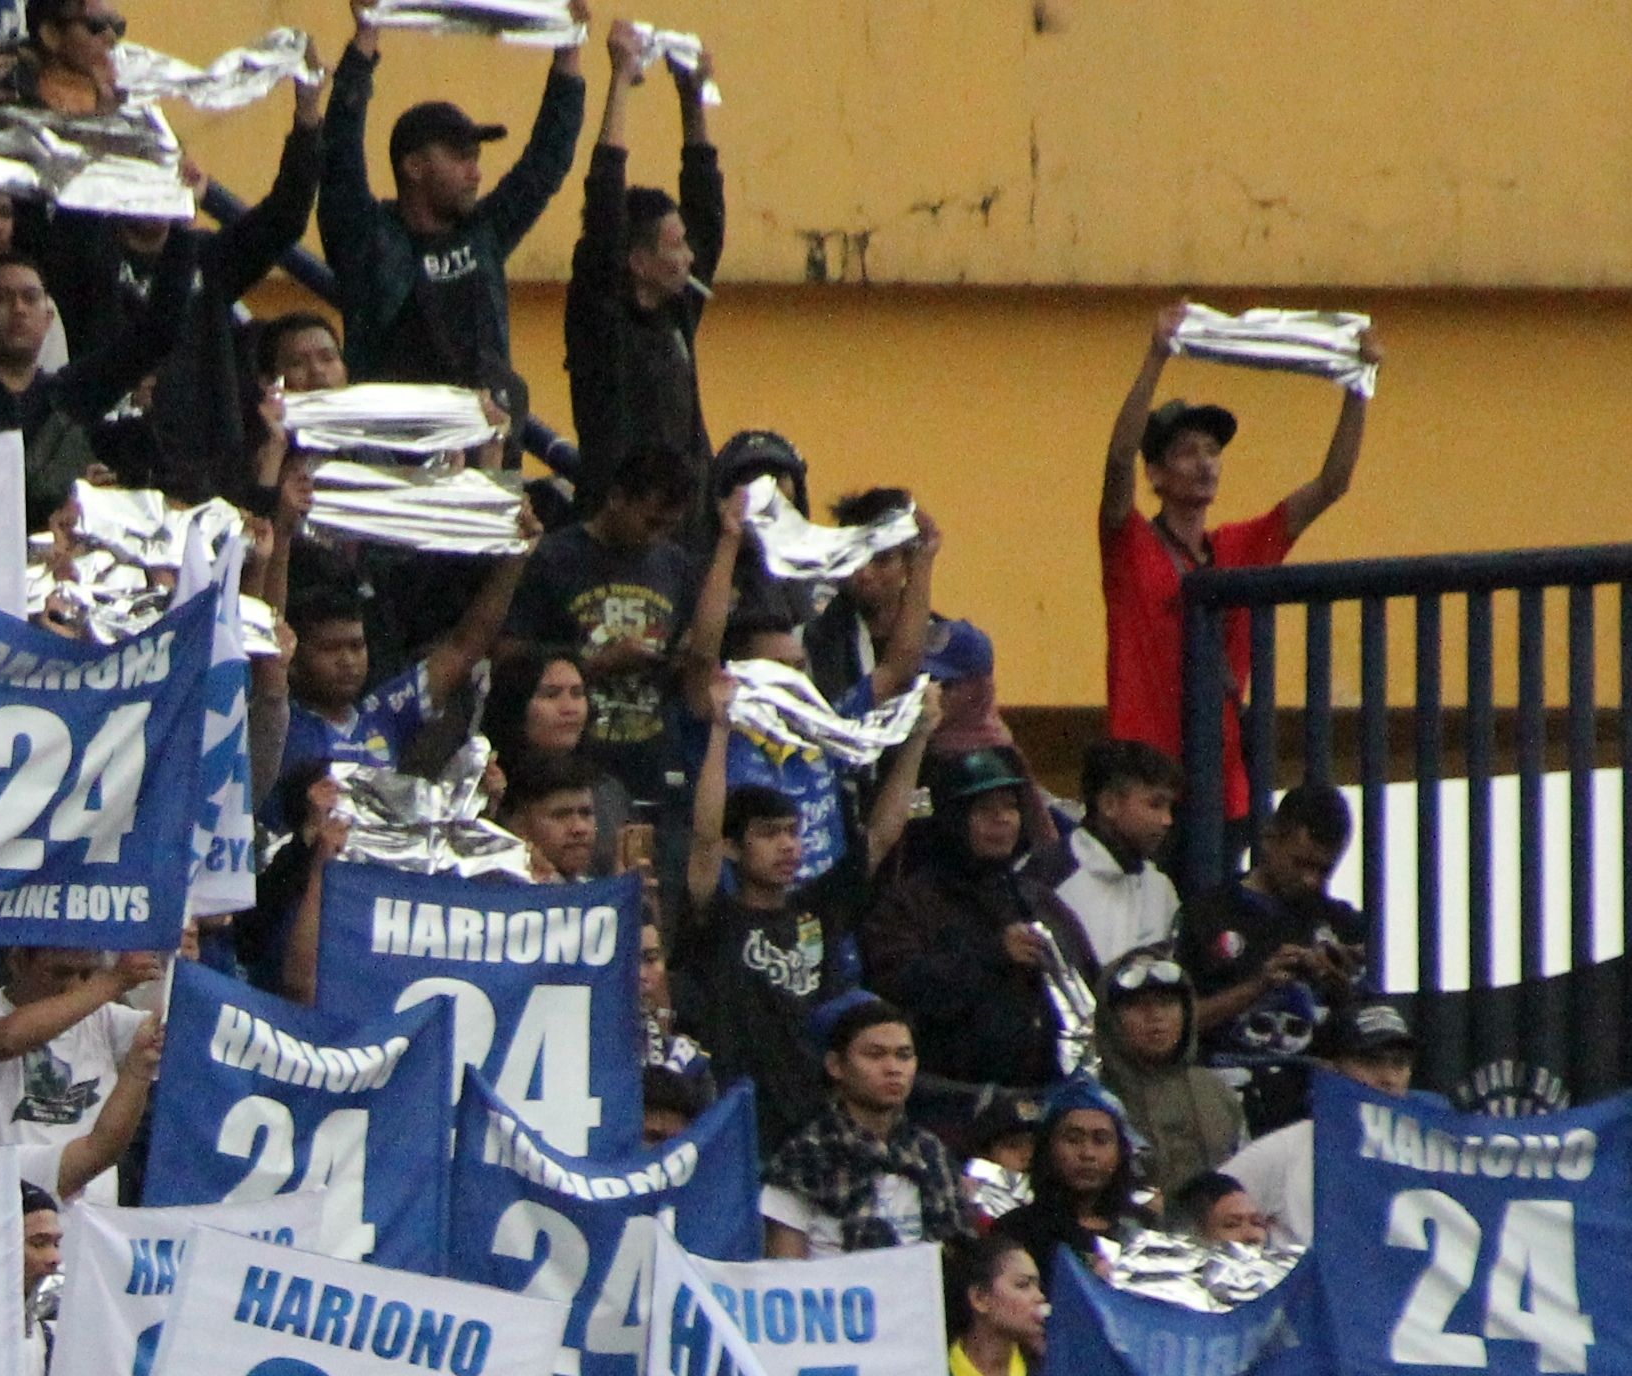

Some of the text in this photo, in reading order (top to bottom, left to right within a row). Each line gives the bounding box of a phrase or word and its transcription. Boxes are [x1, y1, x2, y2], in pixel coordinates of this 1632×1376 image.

[67, 883, 151, 923] BOYS
[372, 897, 619, 968] HARIONO
[210, 1004, 410, 1094] HARIONO
[217, 1096, 375, 1264] 24
[1358, 1103, 1598, 1181] HARIONO
[1384, 1188, 1595, 1374] 24
